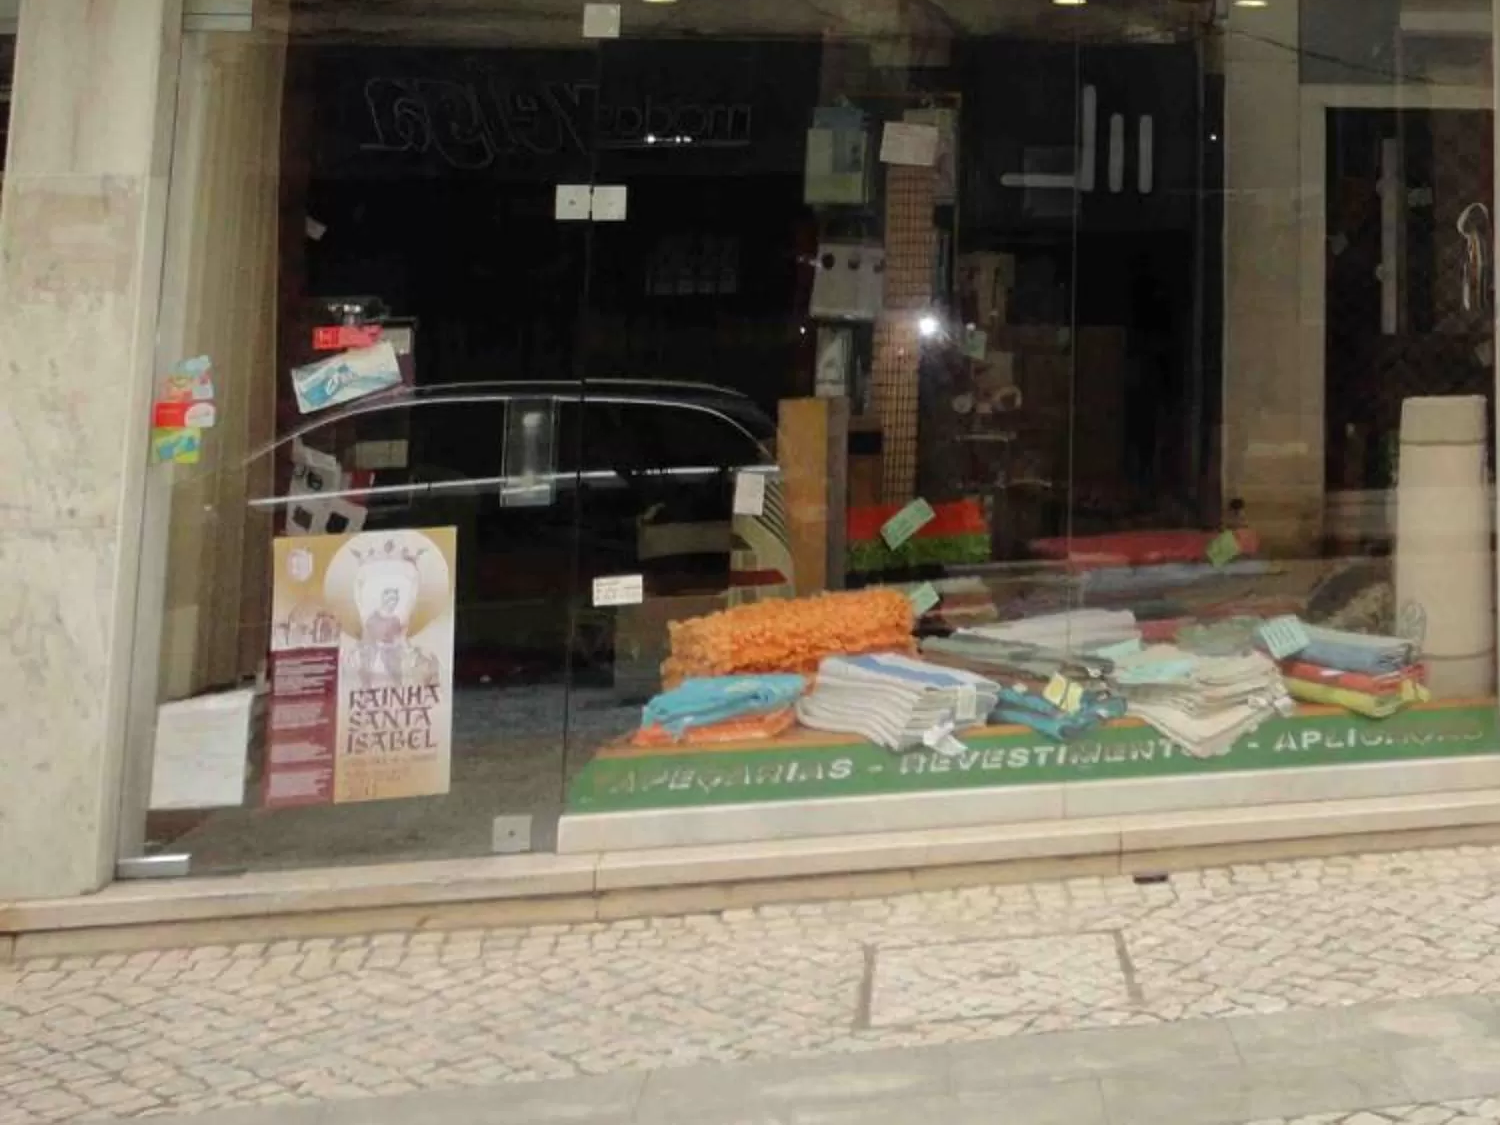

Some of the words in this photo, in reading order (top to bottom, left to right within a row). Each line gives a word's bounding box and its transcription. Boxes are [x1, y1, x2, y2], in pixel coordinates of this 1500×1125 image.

[349, 684, 441, 709] RAINHA
[348, 707, 433, 730] SANTA
[346, 728, 438, 754] ISABEL
